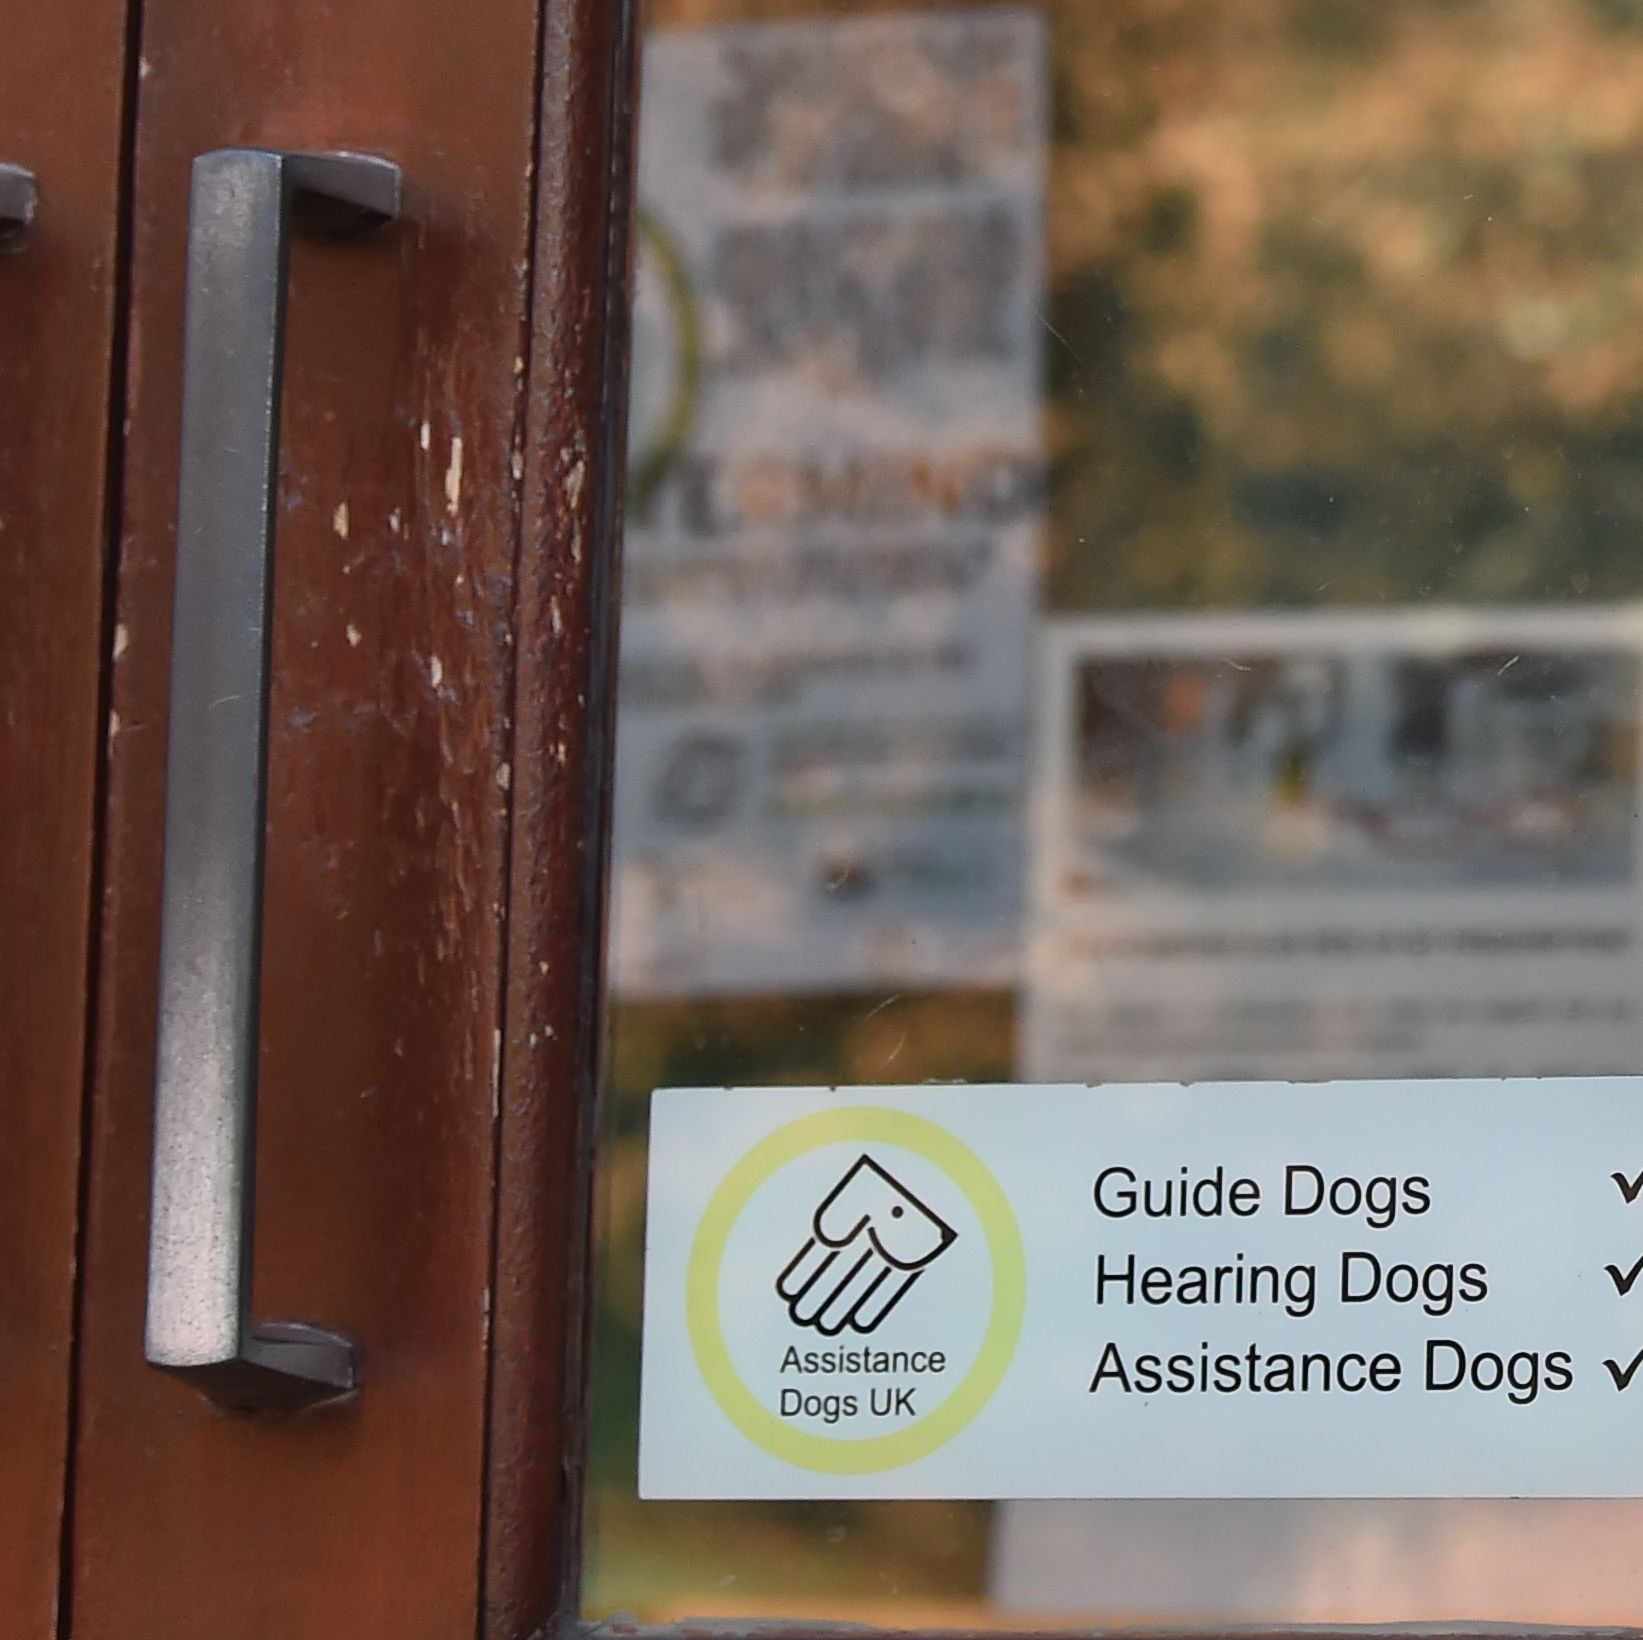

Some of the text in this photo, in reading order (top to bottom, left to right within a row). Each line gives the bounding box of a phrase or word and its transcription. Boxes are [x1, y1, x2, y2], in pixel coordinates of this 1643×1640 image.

[1092, 1163, 1434, 1230] Guide Dogs
[1094, 1250, 1490, 1318] Hearing Dogs
[778, 1344, 948, 1376] Assistance
[1088, 1338, 1577, 1406] Assistance Dogs
[777, 1386, 918, 1423] Dogs UK
